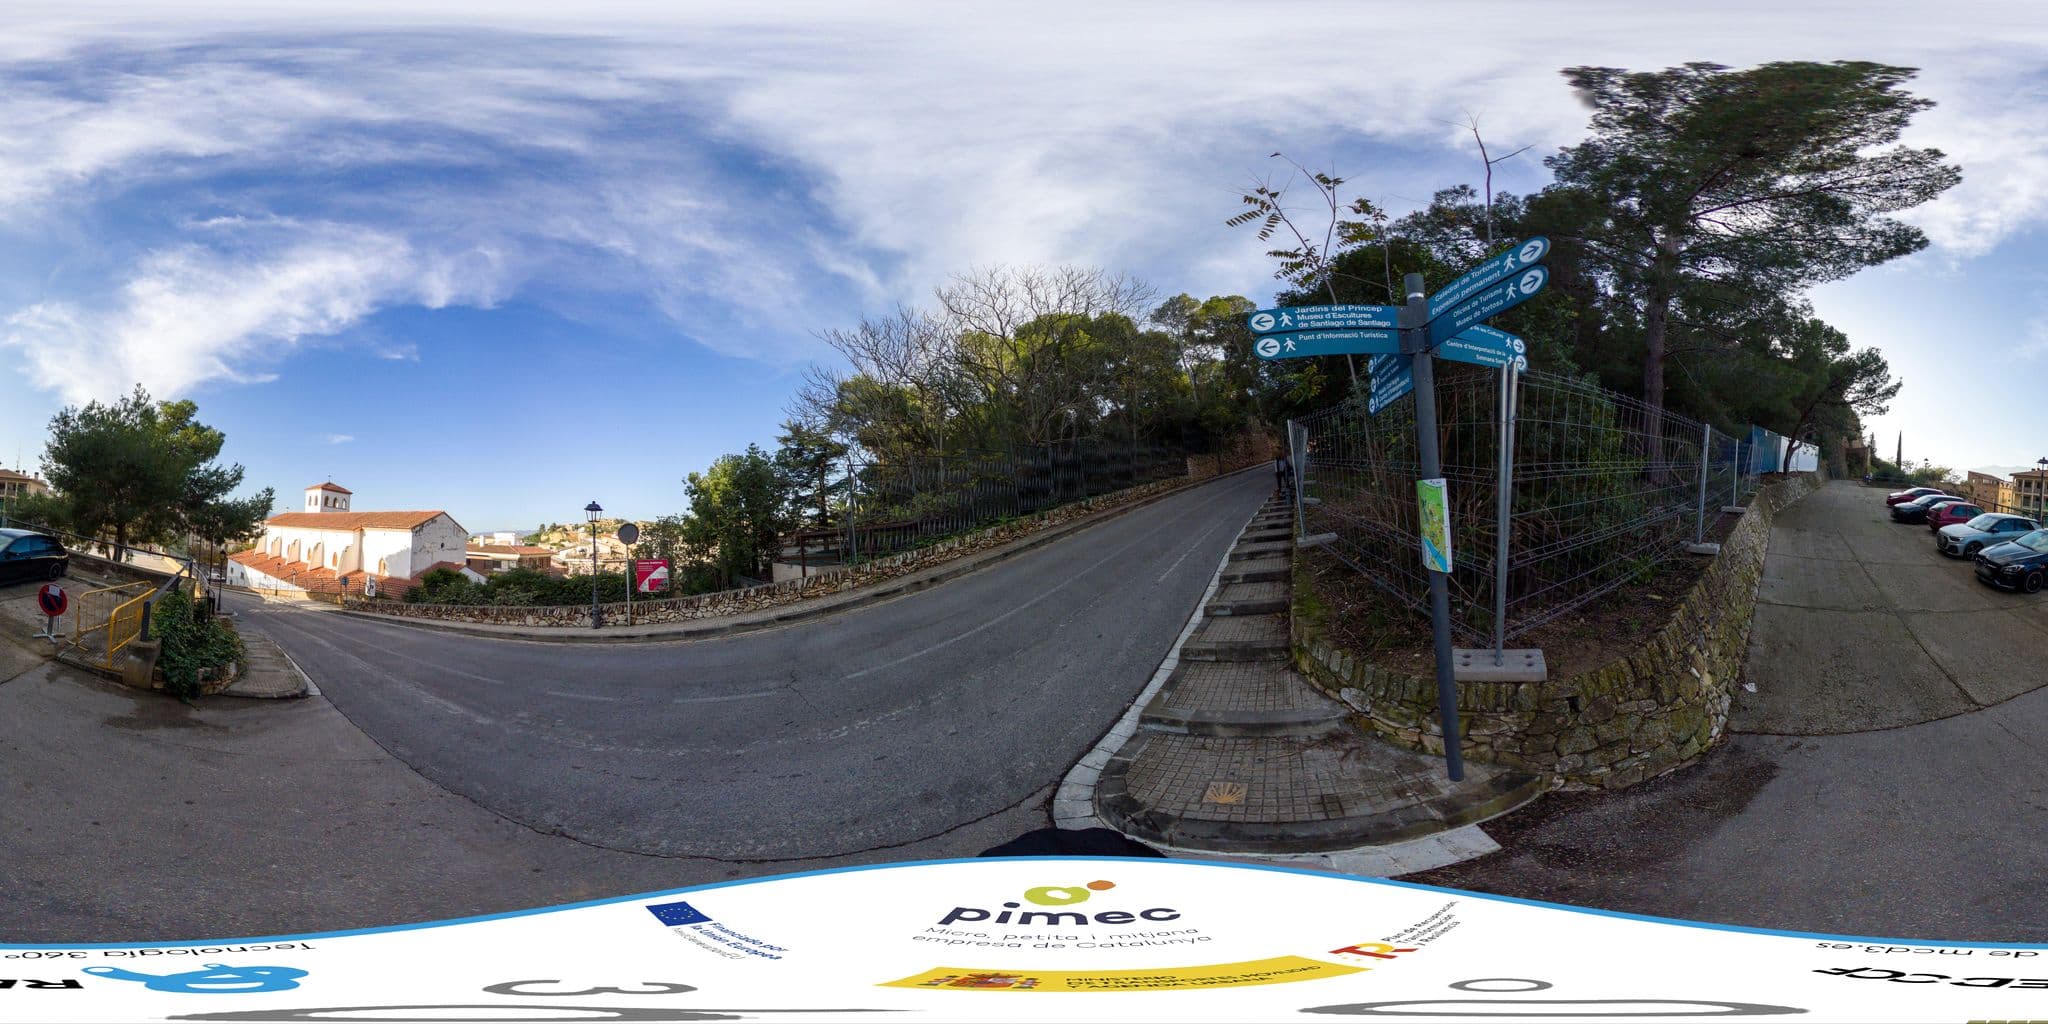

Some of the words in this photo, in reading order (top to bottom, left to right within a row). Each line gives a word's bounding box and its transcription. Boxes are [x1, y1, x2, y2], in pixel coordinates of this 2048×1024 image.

[1461, 277, 1470, 286] de
[1470, 260, 1500, 278] Tortosa
[1461, 270, 1501, 298] permanent
[1296, 313, 1324, 321] Museu
[1358, 320, 1391, 328] Santiago
